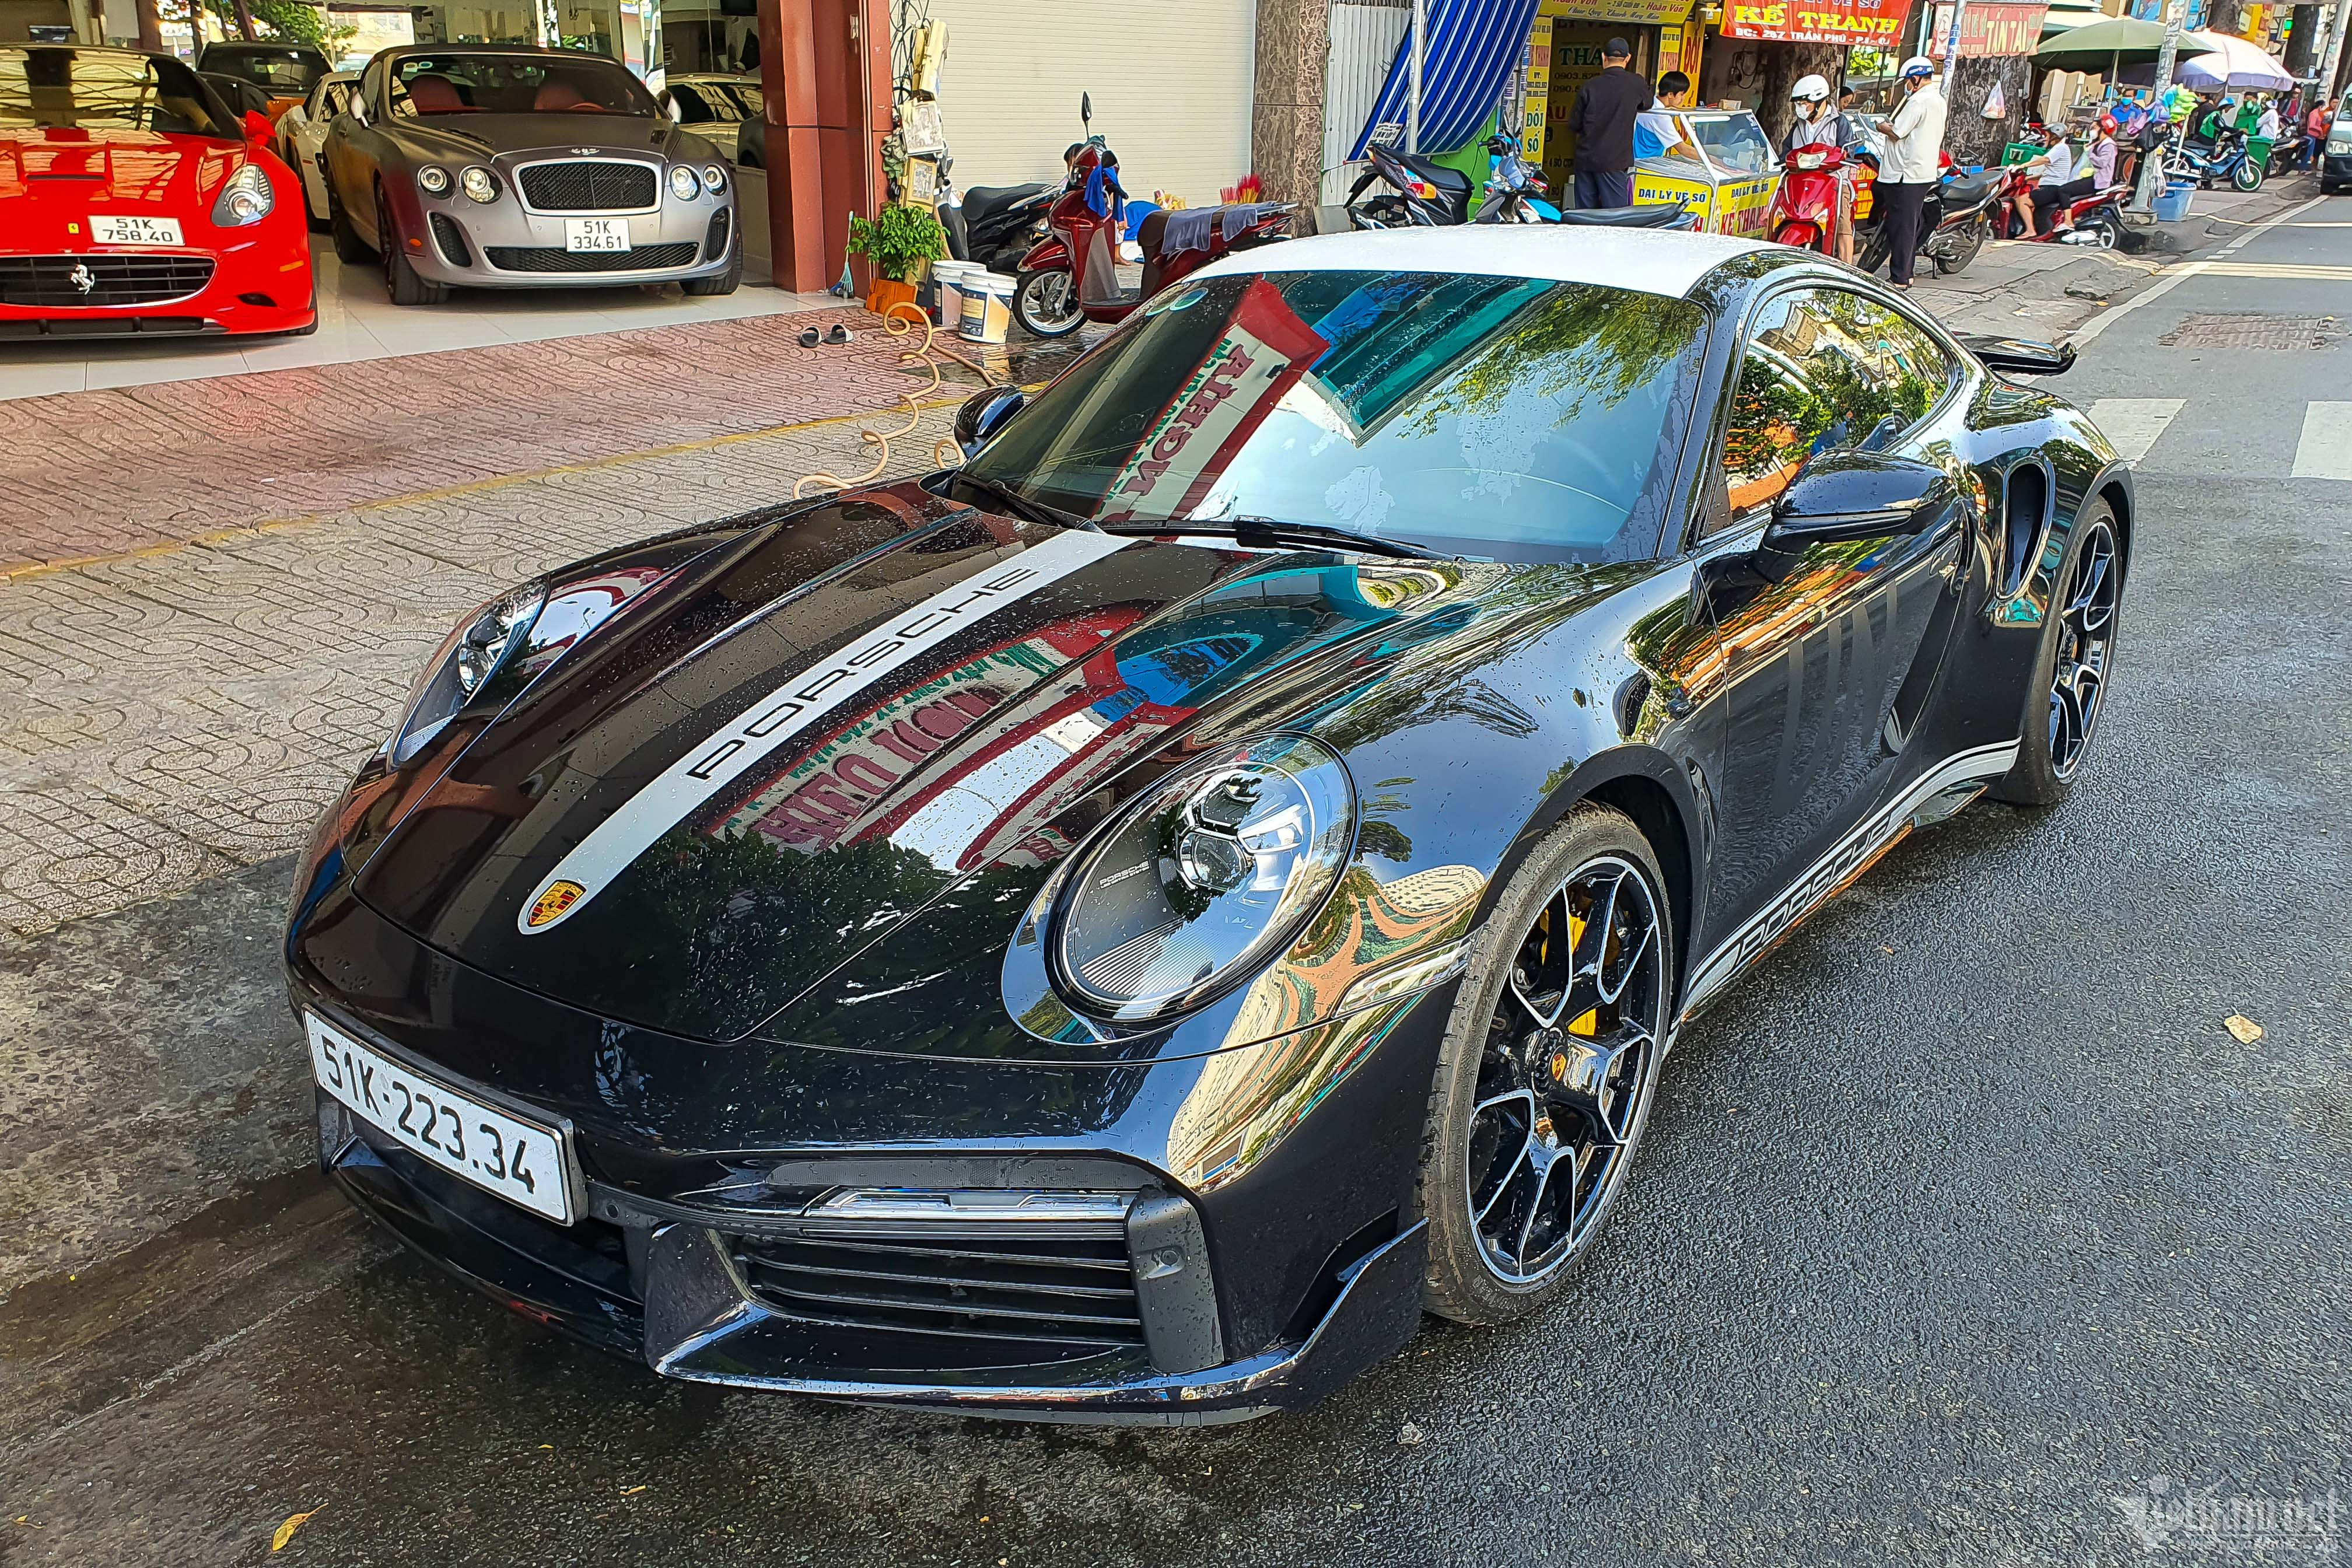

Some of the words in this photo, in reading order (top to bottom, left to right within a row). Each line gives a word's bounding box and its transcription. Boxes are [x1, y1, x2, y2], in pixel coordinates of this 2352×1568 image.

[1734, 3, 1787, 26] KẾ
[1797, 11, 1900, 33] THANH
[1526, 103, 1544, 127] ĐỔI
[1527, 130, 1541, 152] SỐ
[1692, 190, 1707, 202] SỐ
[116, 218, 155, 229] 51K
[584, 220, 611, 234] 51K
[103, 229, 173, 242] 758.40
[573, 236, 621, 249] 334.61
[686, 568, 1040, 780] PORSCHE
[1100, 860, 1149, 885] PORSCHE
[321, 1034, 535, 1195] 51K-223.34
